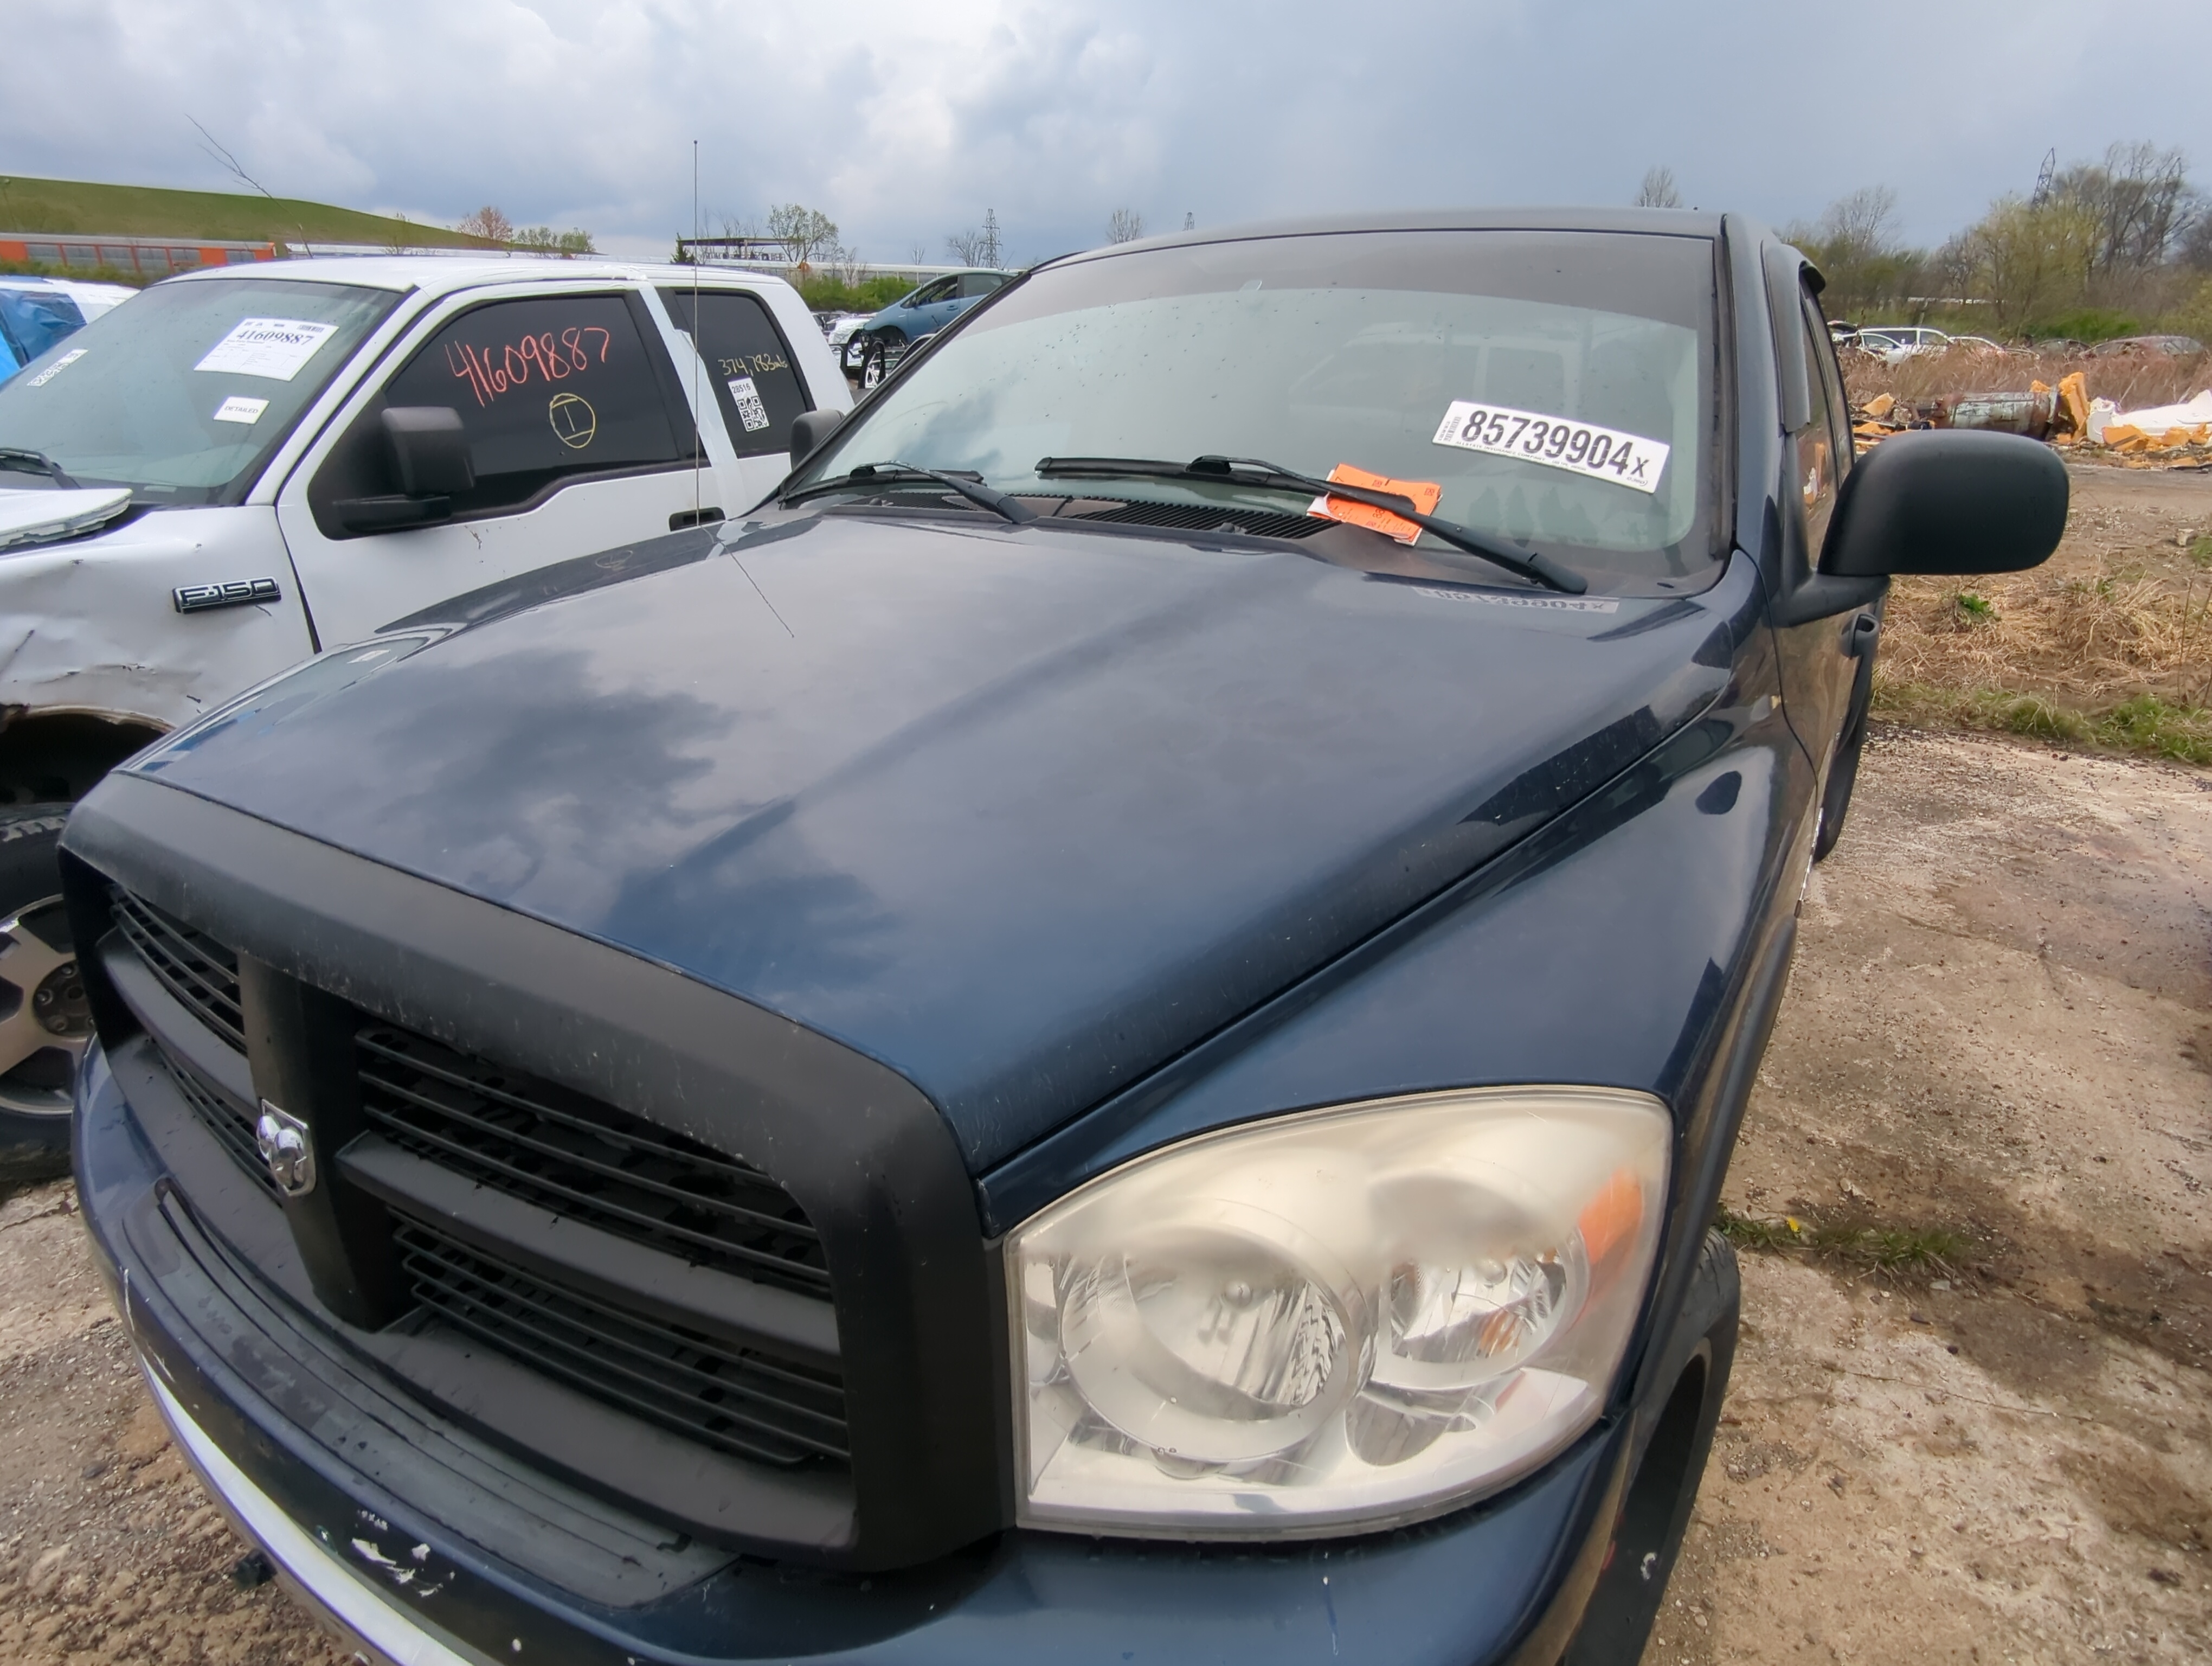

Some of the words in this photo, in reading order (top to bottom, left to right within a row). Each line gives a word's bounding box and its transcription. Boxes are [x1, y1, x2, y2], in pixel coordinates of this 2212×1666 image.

[236, 330, 314, 345] 41609887
[445, 328, 609, 408] 41609887
[731, 383, 751, 394] 28516
[177, 577, 279, 608] F-150
